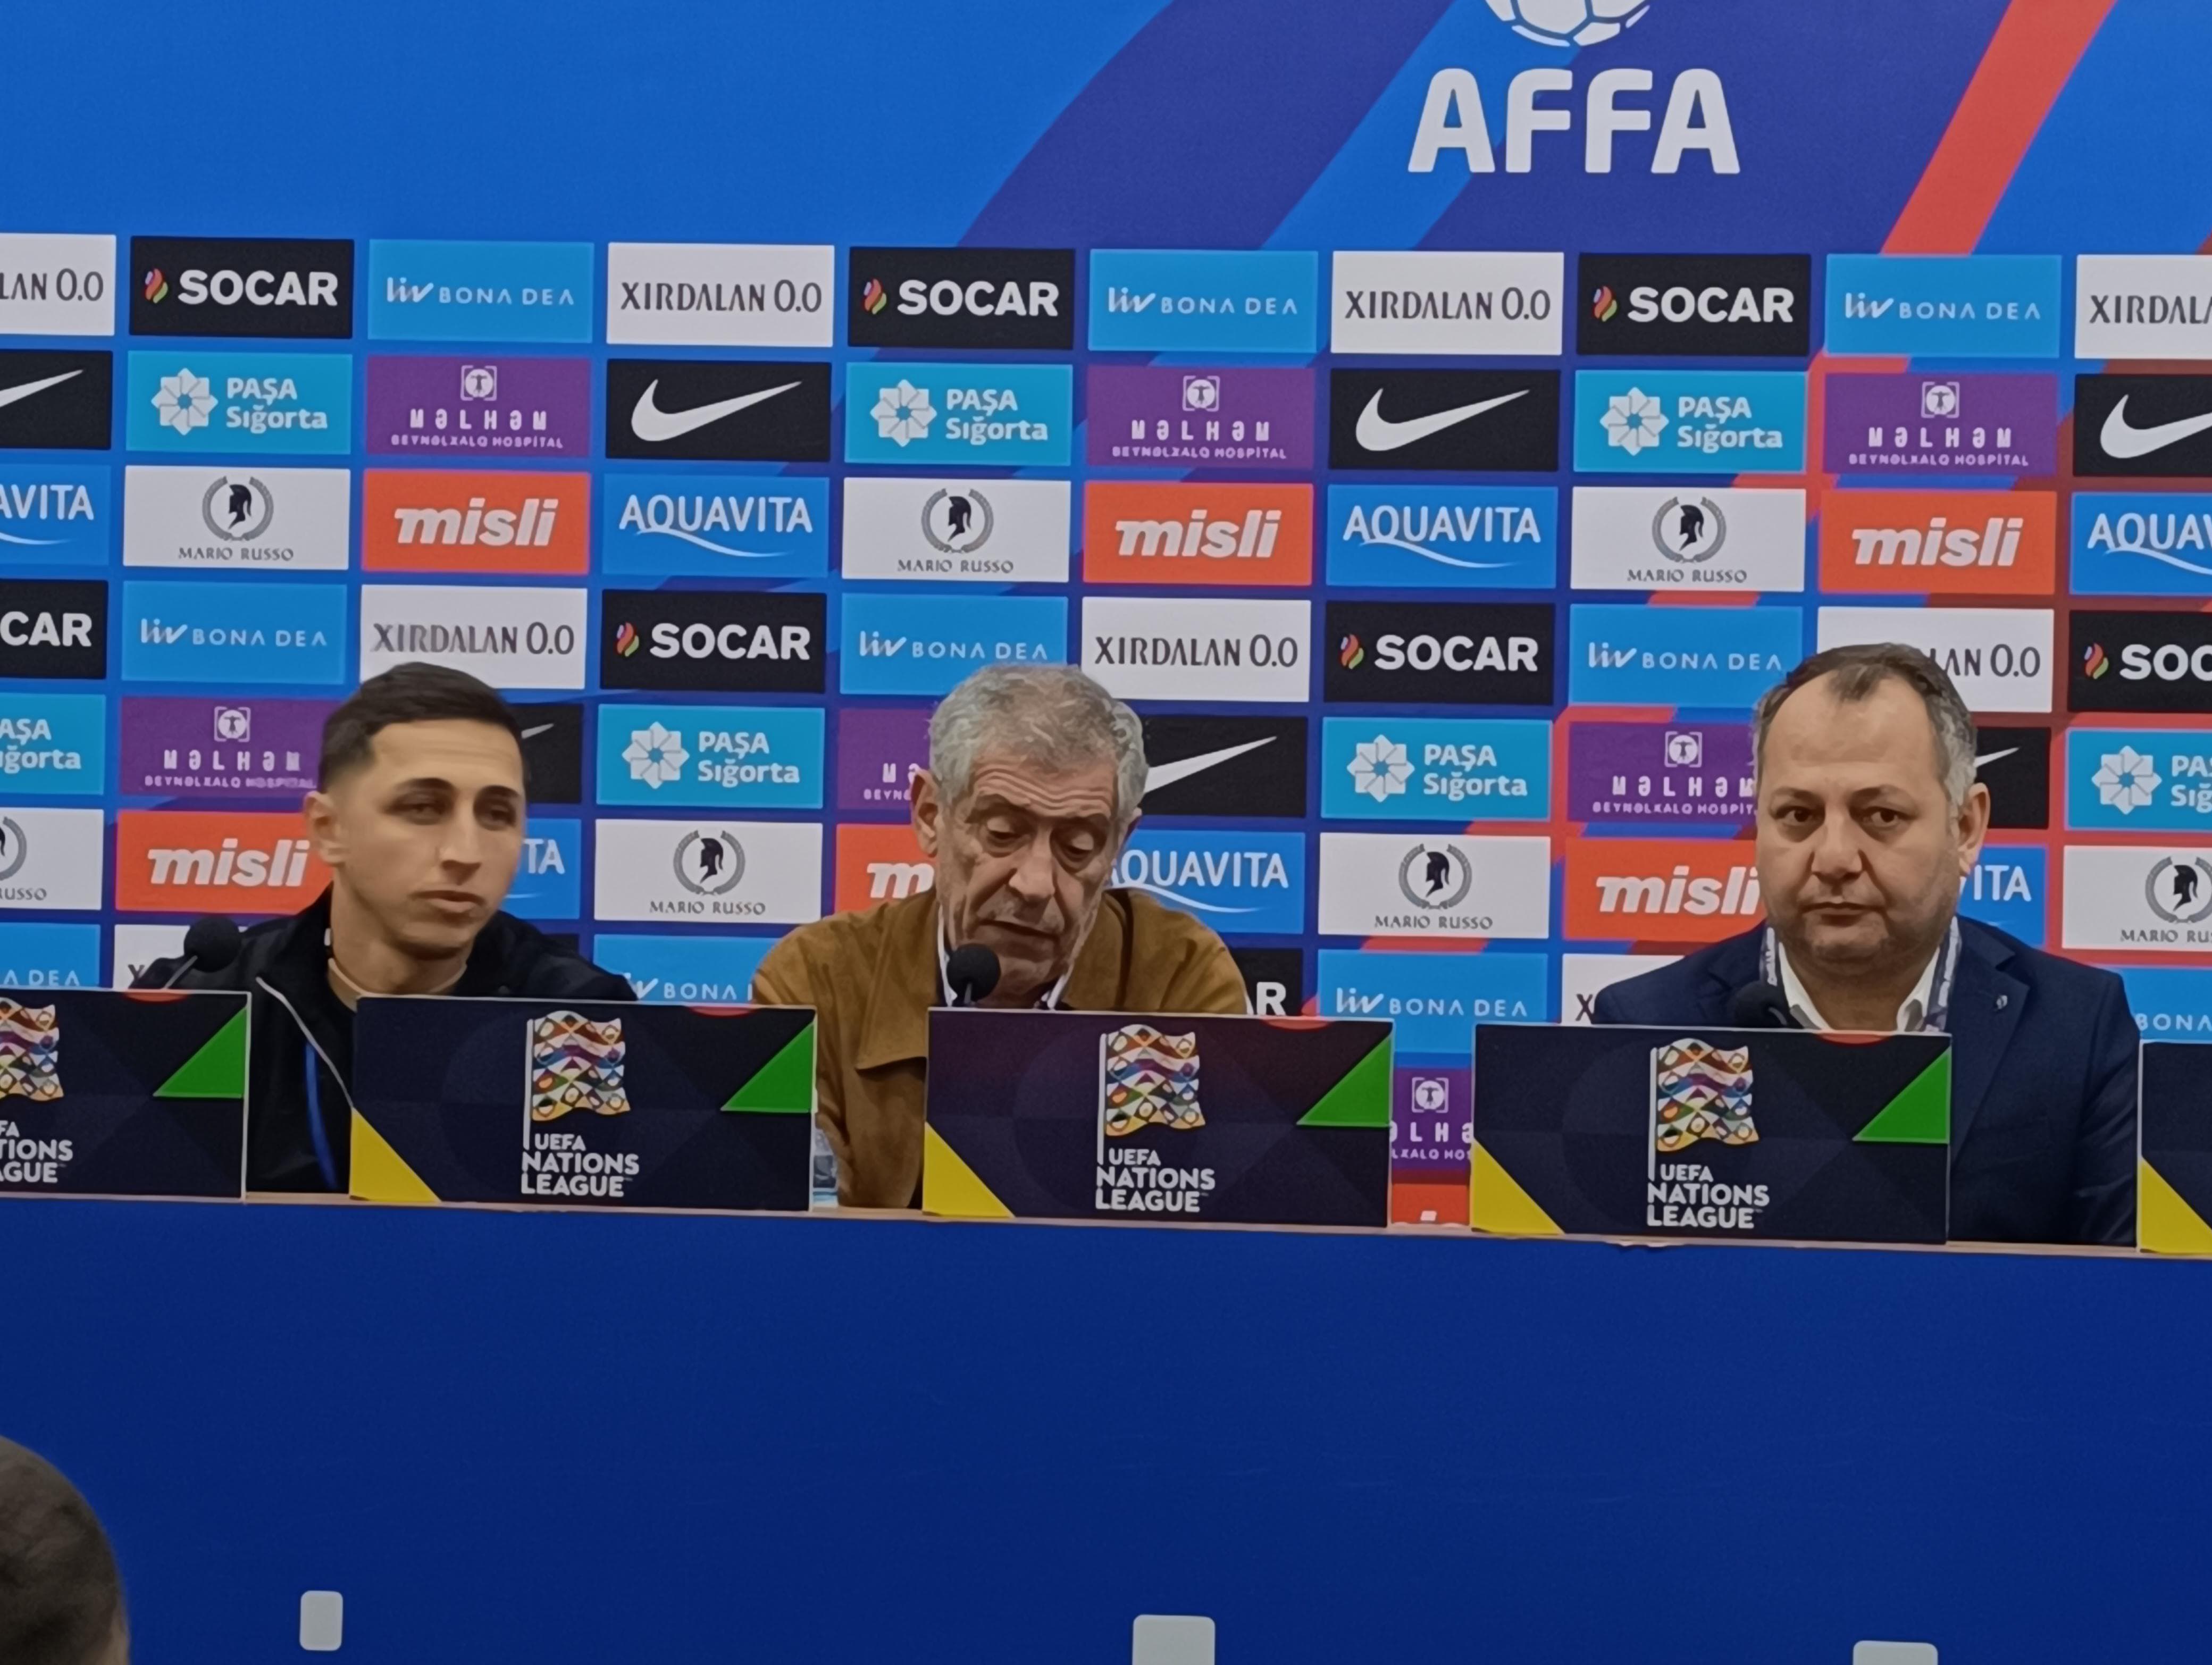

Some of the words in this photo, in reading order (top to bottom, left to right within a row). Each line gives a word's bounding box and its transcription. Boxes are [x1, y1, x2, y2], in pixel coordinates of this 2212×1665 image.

[1408, 68, 1740, 174] AFFA
[178, 270, 338, 306] SOCAR
[439, 287, 512, 304] BONA
[523, 288, 574, 305] DEA
[621, 282, 765, 311] XIRDALAN
[898, 280, 1059, 316] SOCAR
[1161, 297, 1234, 314] BONA
[1245, 298, 1297, 314] DEA
[1345, 291, 1492, 319] XIRDALAN
[1628, 287, 1794, 322] SOCAR
[1900, 302, 1975, 319] BONA
[1987, 303, 2040, 320] DEA
[228, 378, 297, 406] PAŞA
[947, 389, 1018, 417] PAŞA
[1679, 397, 1752, 425] PAŞA
[395, 498, 558, 546] misli
[618, 494, 813, 534] AQUAVITA
[1342, 505, 1541, 543] AQUAVITA
[1116, 509, 1281, 558] misli
[1852, 517, 2023, 566] misli
[179, 548, 232, 560] MARIO
[241, 548, 294, 561] RUSSO
[898, 559, 952, 572] MARIO
[961, 560, 1013, 573] RUSSO
[1628, 570, 1684, 582] MARIO
[1692, 570, 1747, 583] RUSSO
[0, 611, 92, 647] CAR
[193, 629, 265, 645] BONA
[276, 630, 326, 647] DEA
[374, 624, 517, 654] XIRDALAN
[650, 623, 810, 660] SOCAR
[912, 642, 985, 658] BONA
[996, 643, 1047, 659] DEA
[1095, 637, 1240, 666] XIRDALAN
[1375, 635, 1538, 671] SOCAR
[1643, 652, 1717, 669] BONA
[1729, 654, 1781, 670] DEA
[2120, 644, 2212, 681] SOC
[0, 719, 52, 746] AŞA
[699, 731, 769, 760] PAŞA
[1425, 744, 1497, 773] PAŞA
[148, 838, 311, 886] misli
[650, 901, 704, 914] MARIO
[713, 902, 765, 915] RUSSO
[1375, 916, 1430, 928] MARIO
[1439, 916, 1493, 930] RUSSO
[2121, 930, 2178, 942] MARIO
[664, 983, 738, 1000] BONA
[1389, 998, 1463, 1015] BONA
[1474, 999, 1527, 1017] DEA
[535, 1134, 586, 1151] UEFA
[522, 1151, 639, 1175] NATIONS
[1109, 1148, 1161, 1167] UEFA
[521, 1172, 625, 1197] LEAGUE
[1096, 1167, 1215, 1191] NATIONS
[1661, 1164, 1713, 1182] UEFA
[1095, 1189, 1201, 1212] LEAGUE
[1648, 1183, 1770, 1207] NATIONS
[1647, 1206, 1754, 1228] LEAGUE
